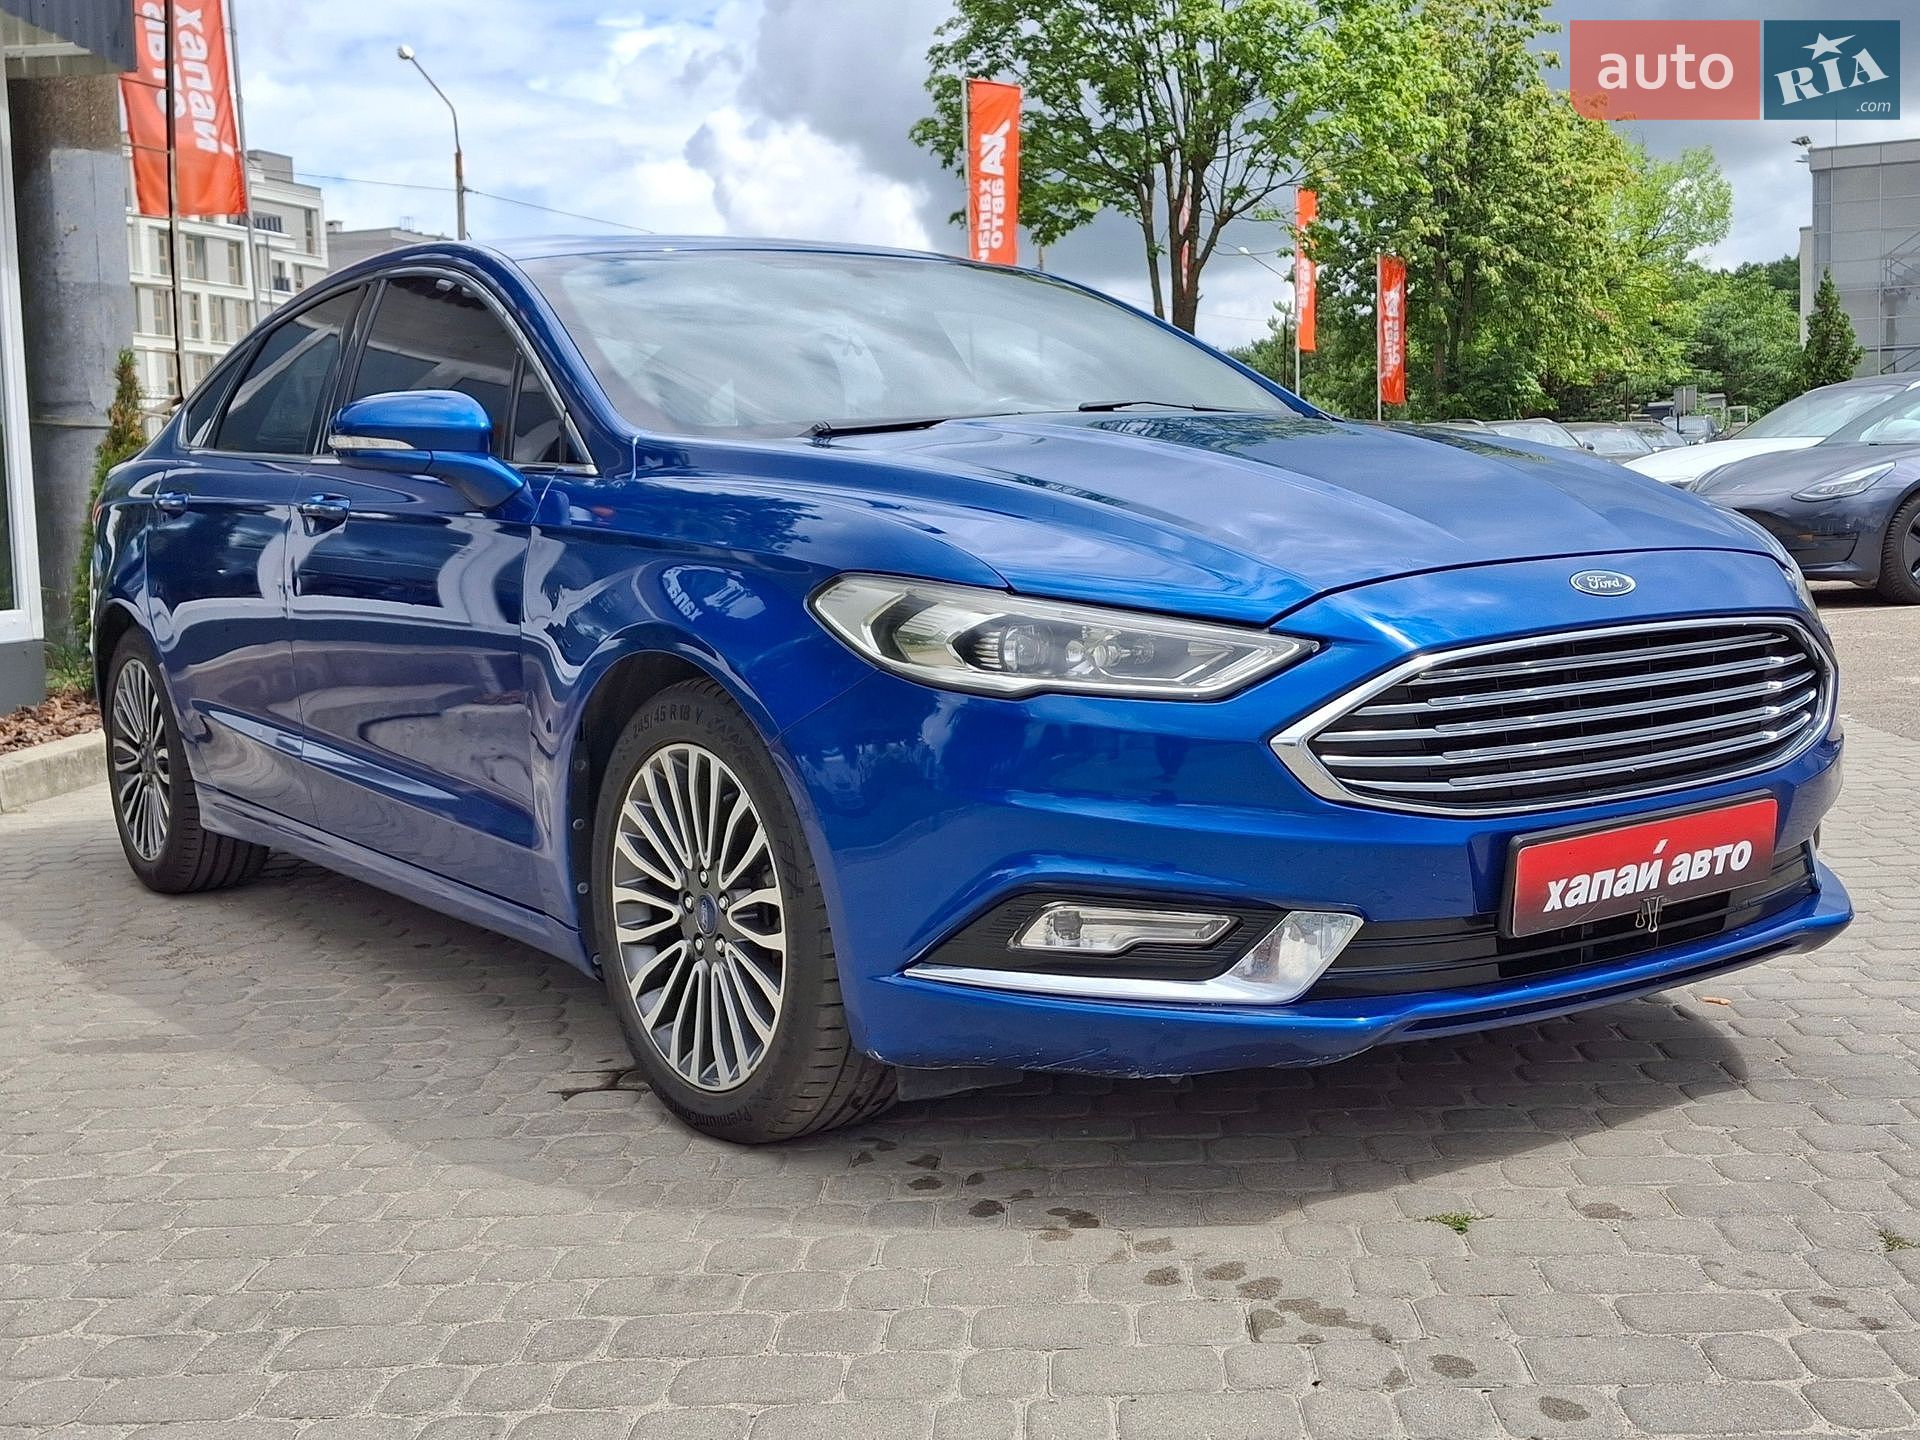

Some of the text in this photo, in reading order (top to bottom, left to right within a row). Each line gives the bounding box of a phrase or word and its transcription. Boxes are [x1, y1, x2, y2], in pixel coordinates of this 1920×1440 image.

[174, 4, 235, 158] хапай
[1586, 575, 1623, 590] Ford
[1542, 839, 1753, 913] хапай авто
